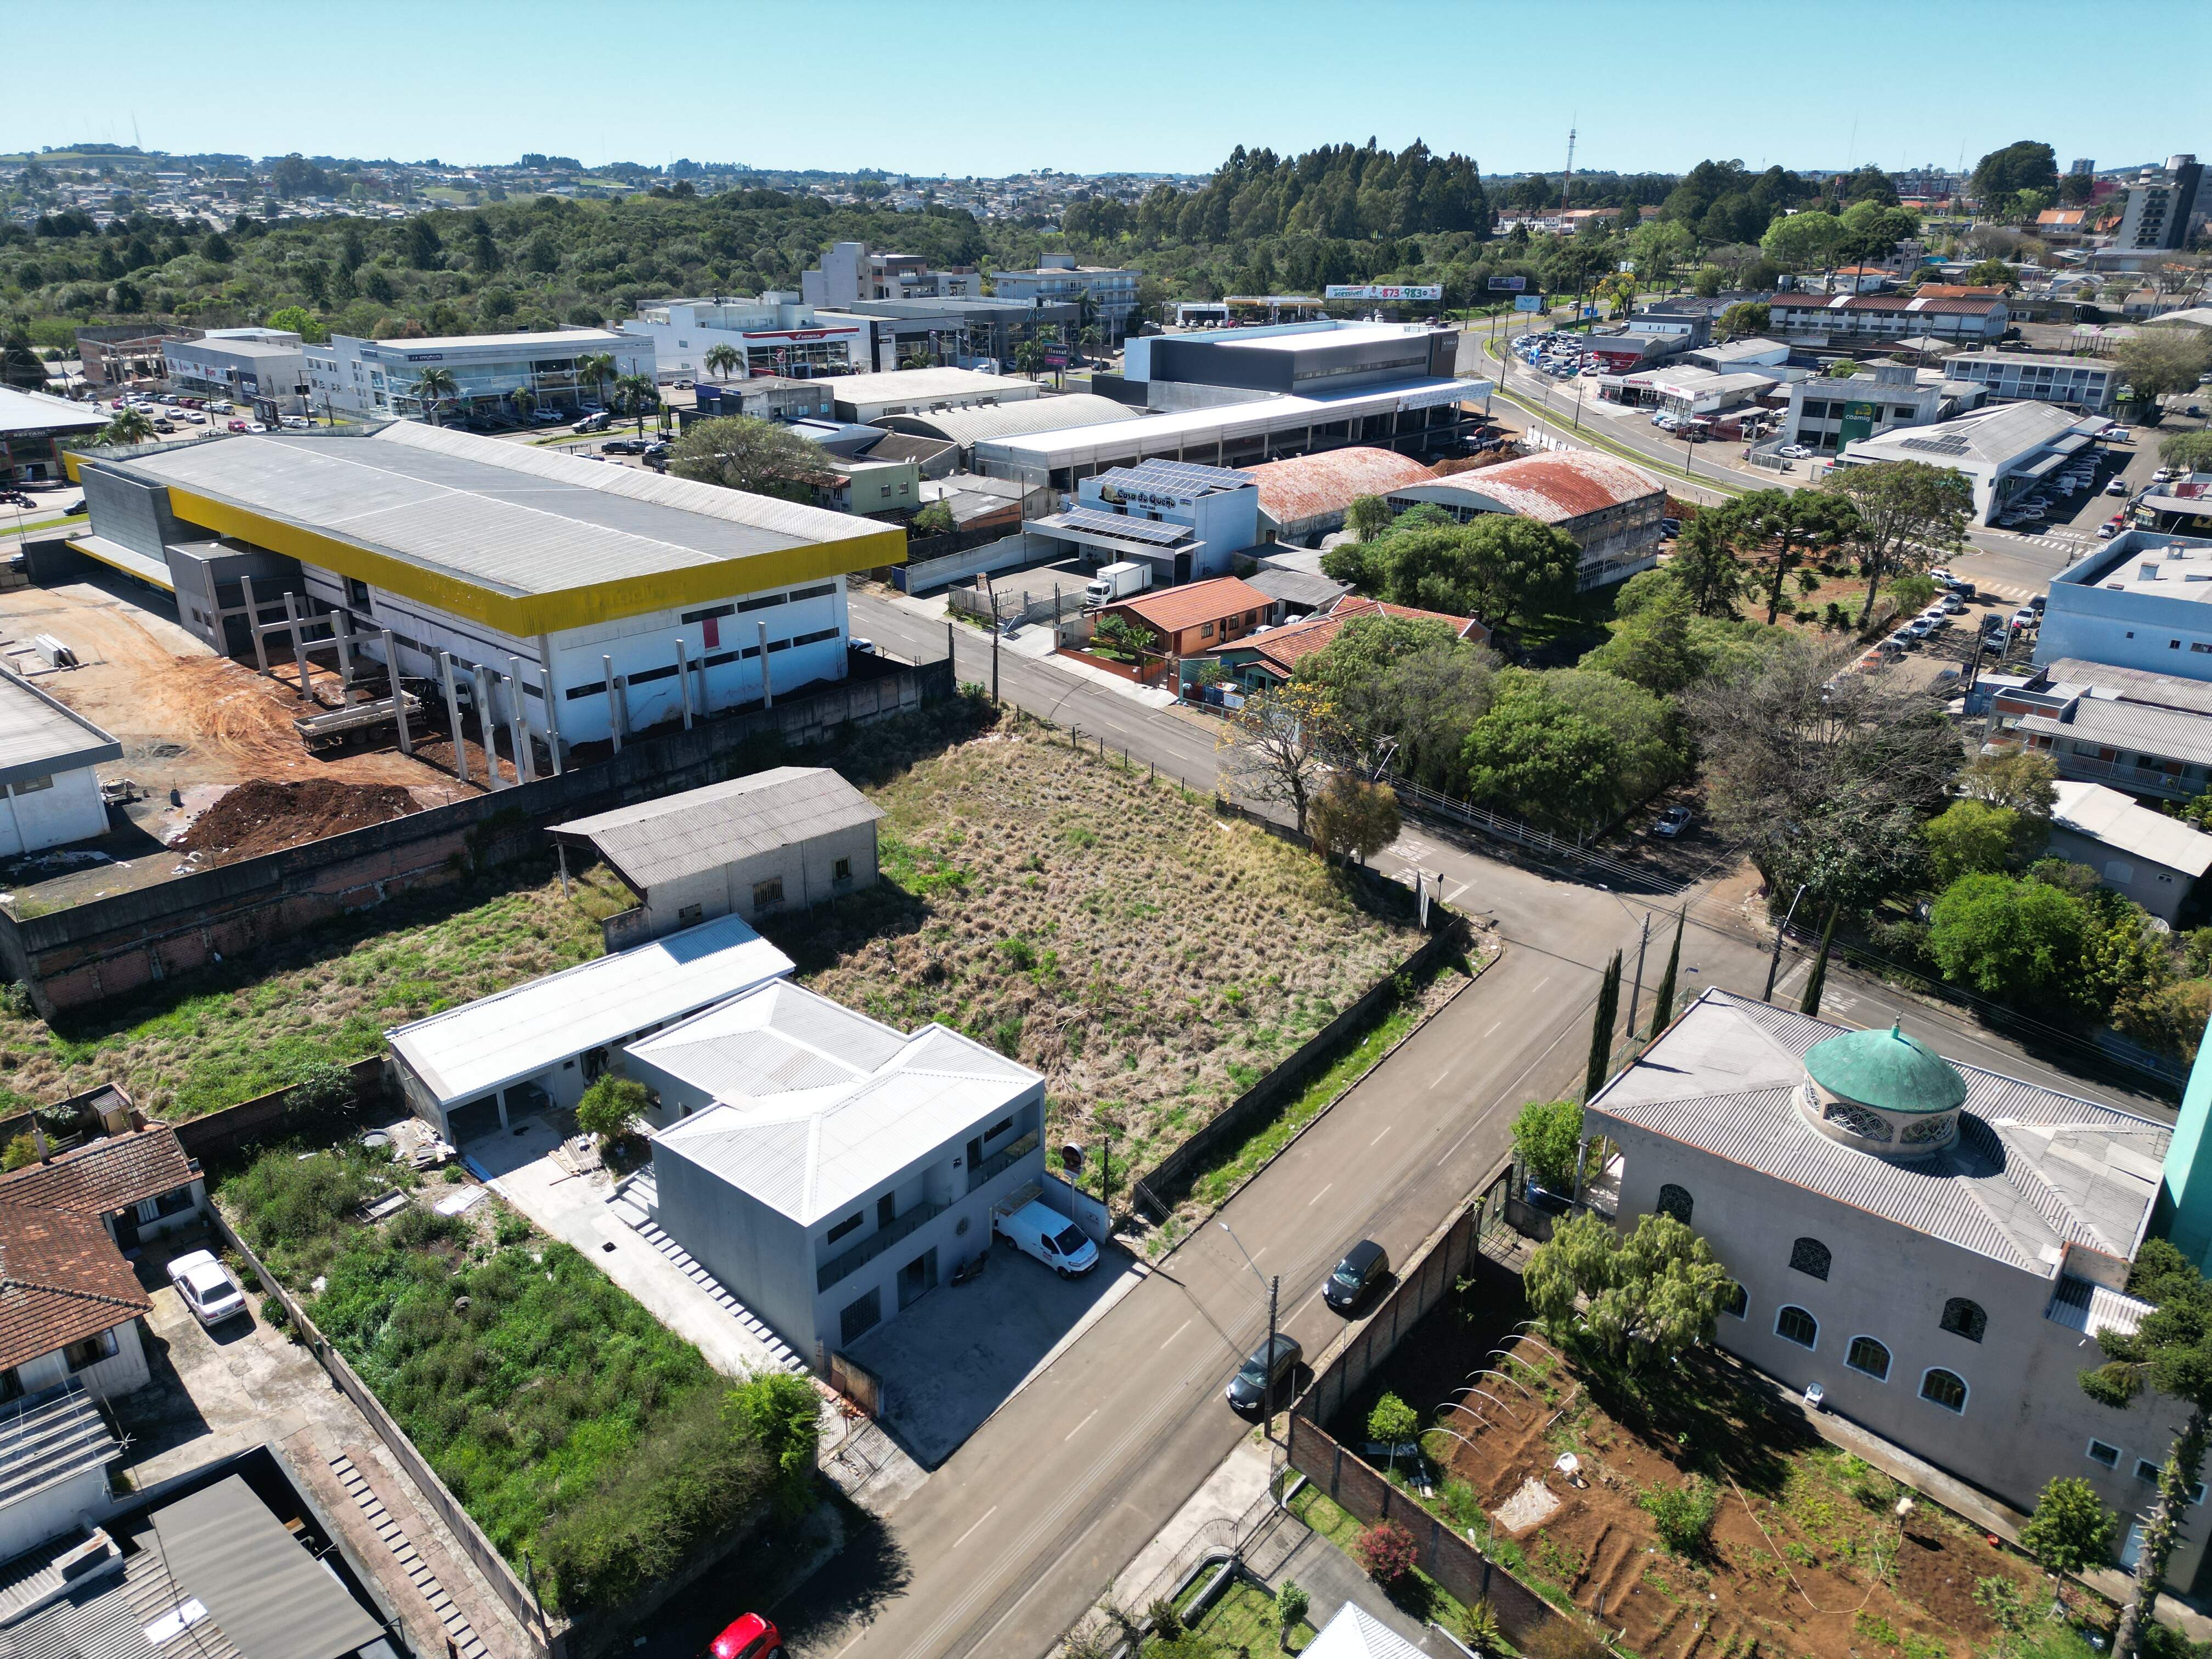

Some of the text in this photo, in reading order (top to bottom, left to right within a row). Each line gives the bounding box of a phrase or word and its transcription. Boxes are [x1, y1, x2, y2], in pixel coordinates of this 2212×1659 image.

[1383, 289, 1400, 297] 873
[1404, 288, 1422, 297] 983
[1117, 489, 1137, 501] Casa
[1138, 492, 1148, 503] do
[1149, 494, 1176, 509] Queijo
